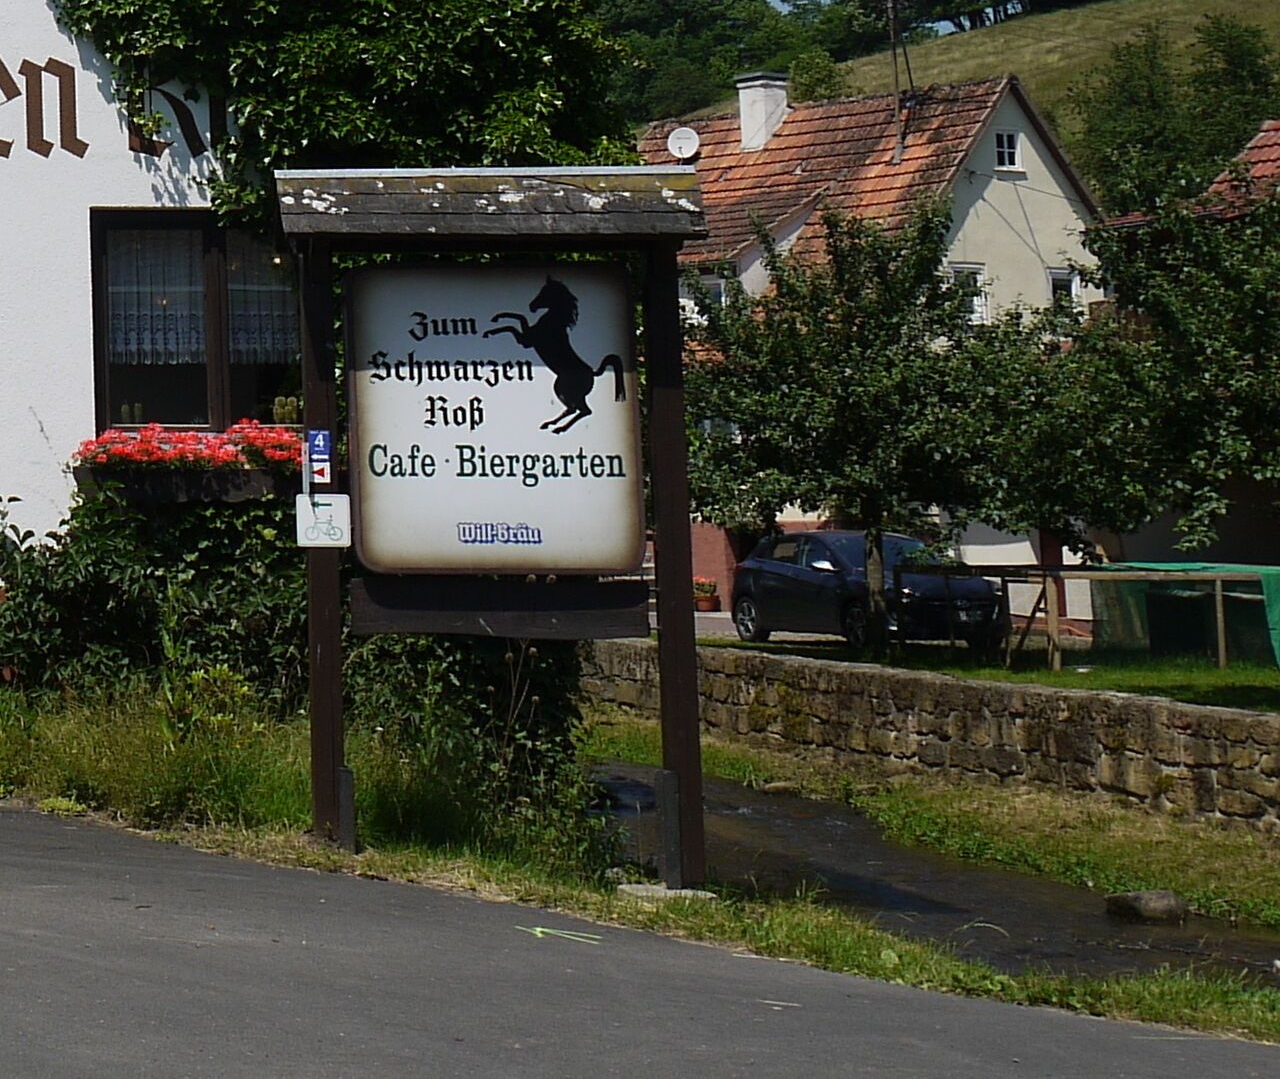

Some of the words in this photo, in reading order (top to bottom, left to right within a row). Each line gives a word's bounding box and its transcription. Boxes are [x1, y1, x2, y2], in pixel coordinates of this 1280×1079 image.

[408, 312, 477, 341] Zum
[368, 350, 534, 387] Schwarzen
[424, 395, 484, 430] Roß
[314, 434, 324, 448] 4
[368, 443, 437, 478] Cafe
[455, 444, 626, 487] Biergarten
